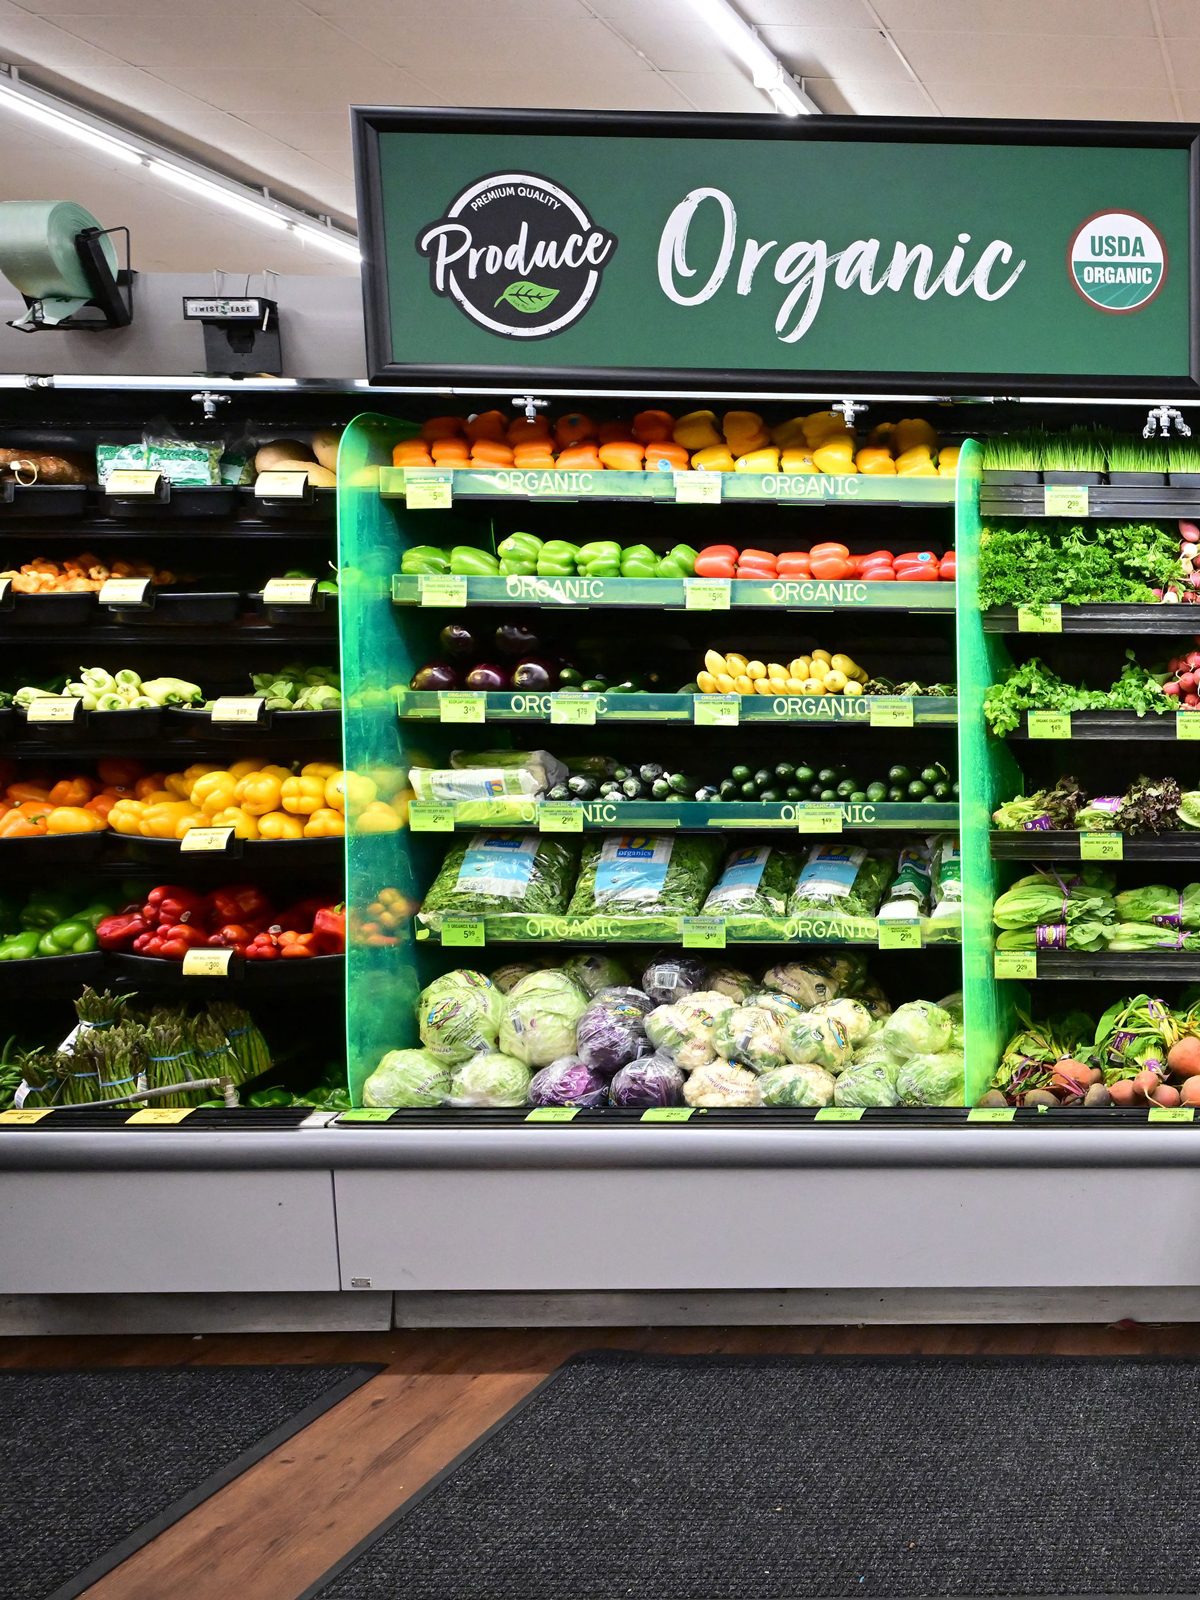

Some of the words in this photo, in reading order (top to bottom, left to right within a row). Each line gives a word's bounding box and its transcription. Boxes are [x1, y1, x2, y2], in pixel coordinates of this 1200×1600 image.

[470, 186, 515, 211] PREMIUM
[517, 186, 561, 210] QUALITY
[1090, 235, 1145, 257] USDA
[421, 221, 612, 291] Produce
[657, 187, 1027, 343] Organic
[1083, 266, 1153, 285] ORGANIC
[494, 472, 593, 492] ORGANIC
[761, 475, 859, 495] ORGANIC
[1067, 501, 1079, 509] 299
[506, 579, 604, 598] ORGANIC
[771, 582, 867, 601] ORGANIC
[511, 695, 608, 714] ORGC
[773, 697, 870, 716] ORGANIC
[1051, 725, 1061, 733] 149
[521, 804, 617, 822] ONIC
[781, 805, 875, 823] ONIC
[618, 849, 653, 858] organics
[1102, 846, 1114, 854] 229
[463, 931, 476, 939] 599
[526, 918, 622, 937] ORGANIC
[784, 920, 878, 939] ORGANIC
[900, 933, 912, 941] 299
[1016, 964, 1028, 973] 229
